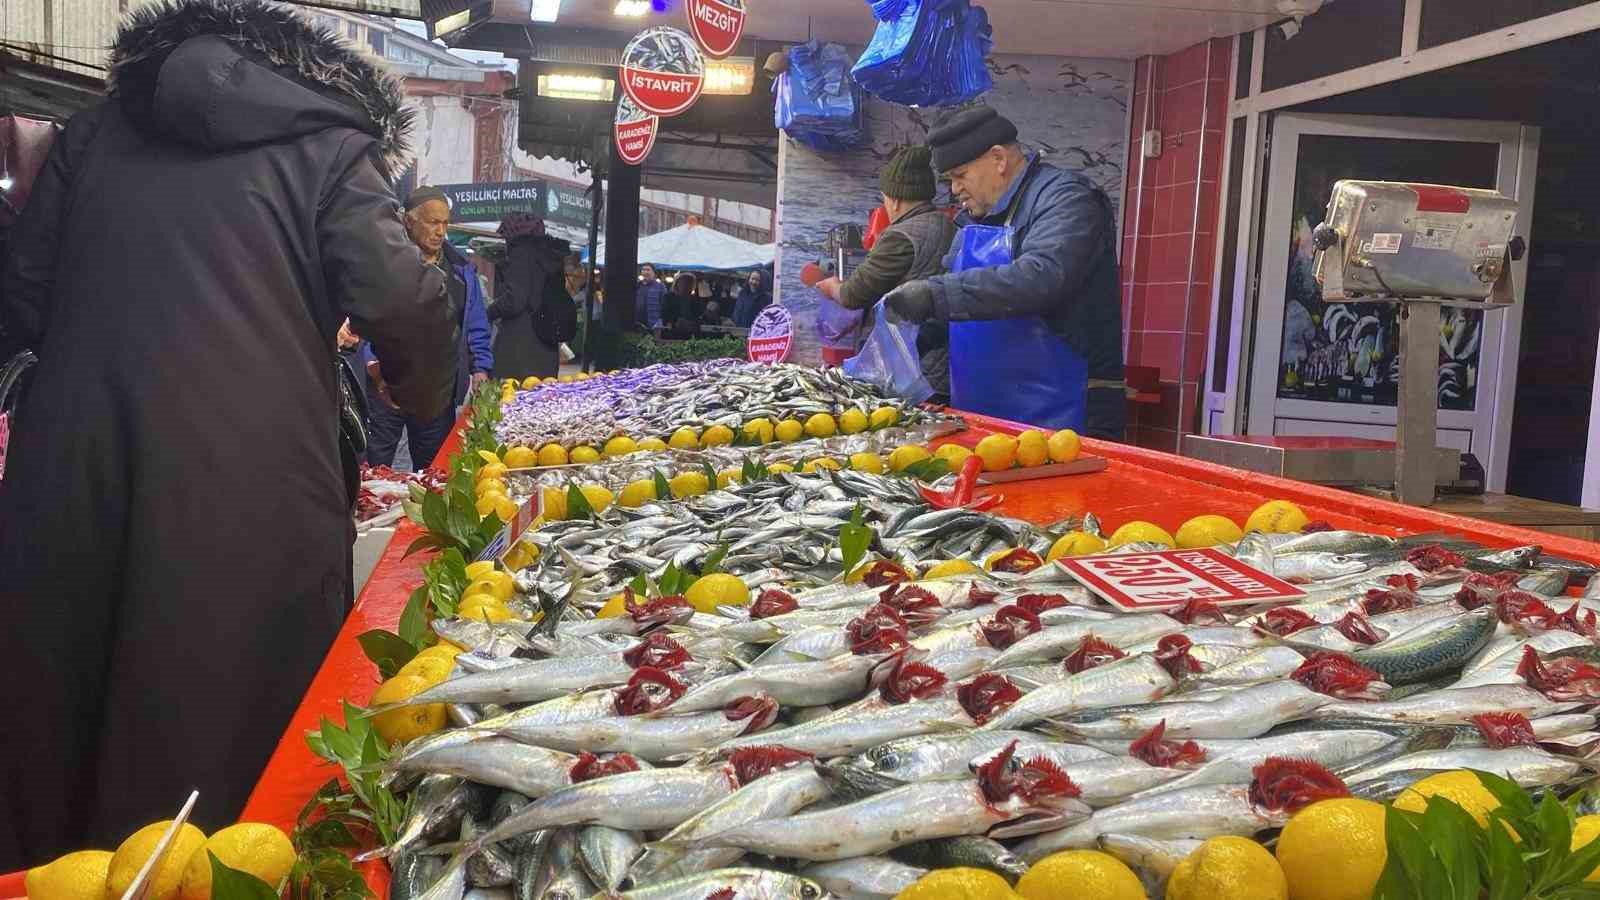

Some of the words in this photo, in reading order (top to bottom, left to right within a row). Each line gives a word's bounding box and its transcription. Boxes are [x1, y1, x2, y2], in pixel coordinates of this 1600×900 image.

[695, 5, 737, 33] MEZGİT
[631, 74, 694, 93] İSTAVRİT
[619, 124, 651, 139] KARADENİZ
[625, 137, 644, 152] HAMSİ
[502, 188, 538, 200] MALTAŞ
[752, 341, 785, 352] KARADENİZ
[1088, 557, 1193, 587] 250
[1175, 553, 1280, 595] USKUMRU
